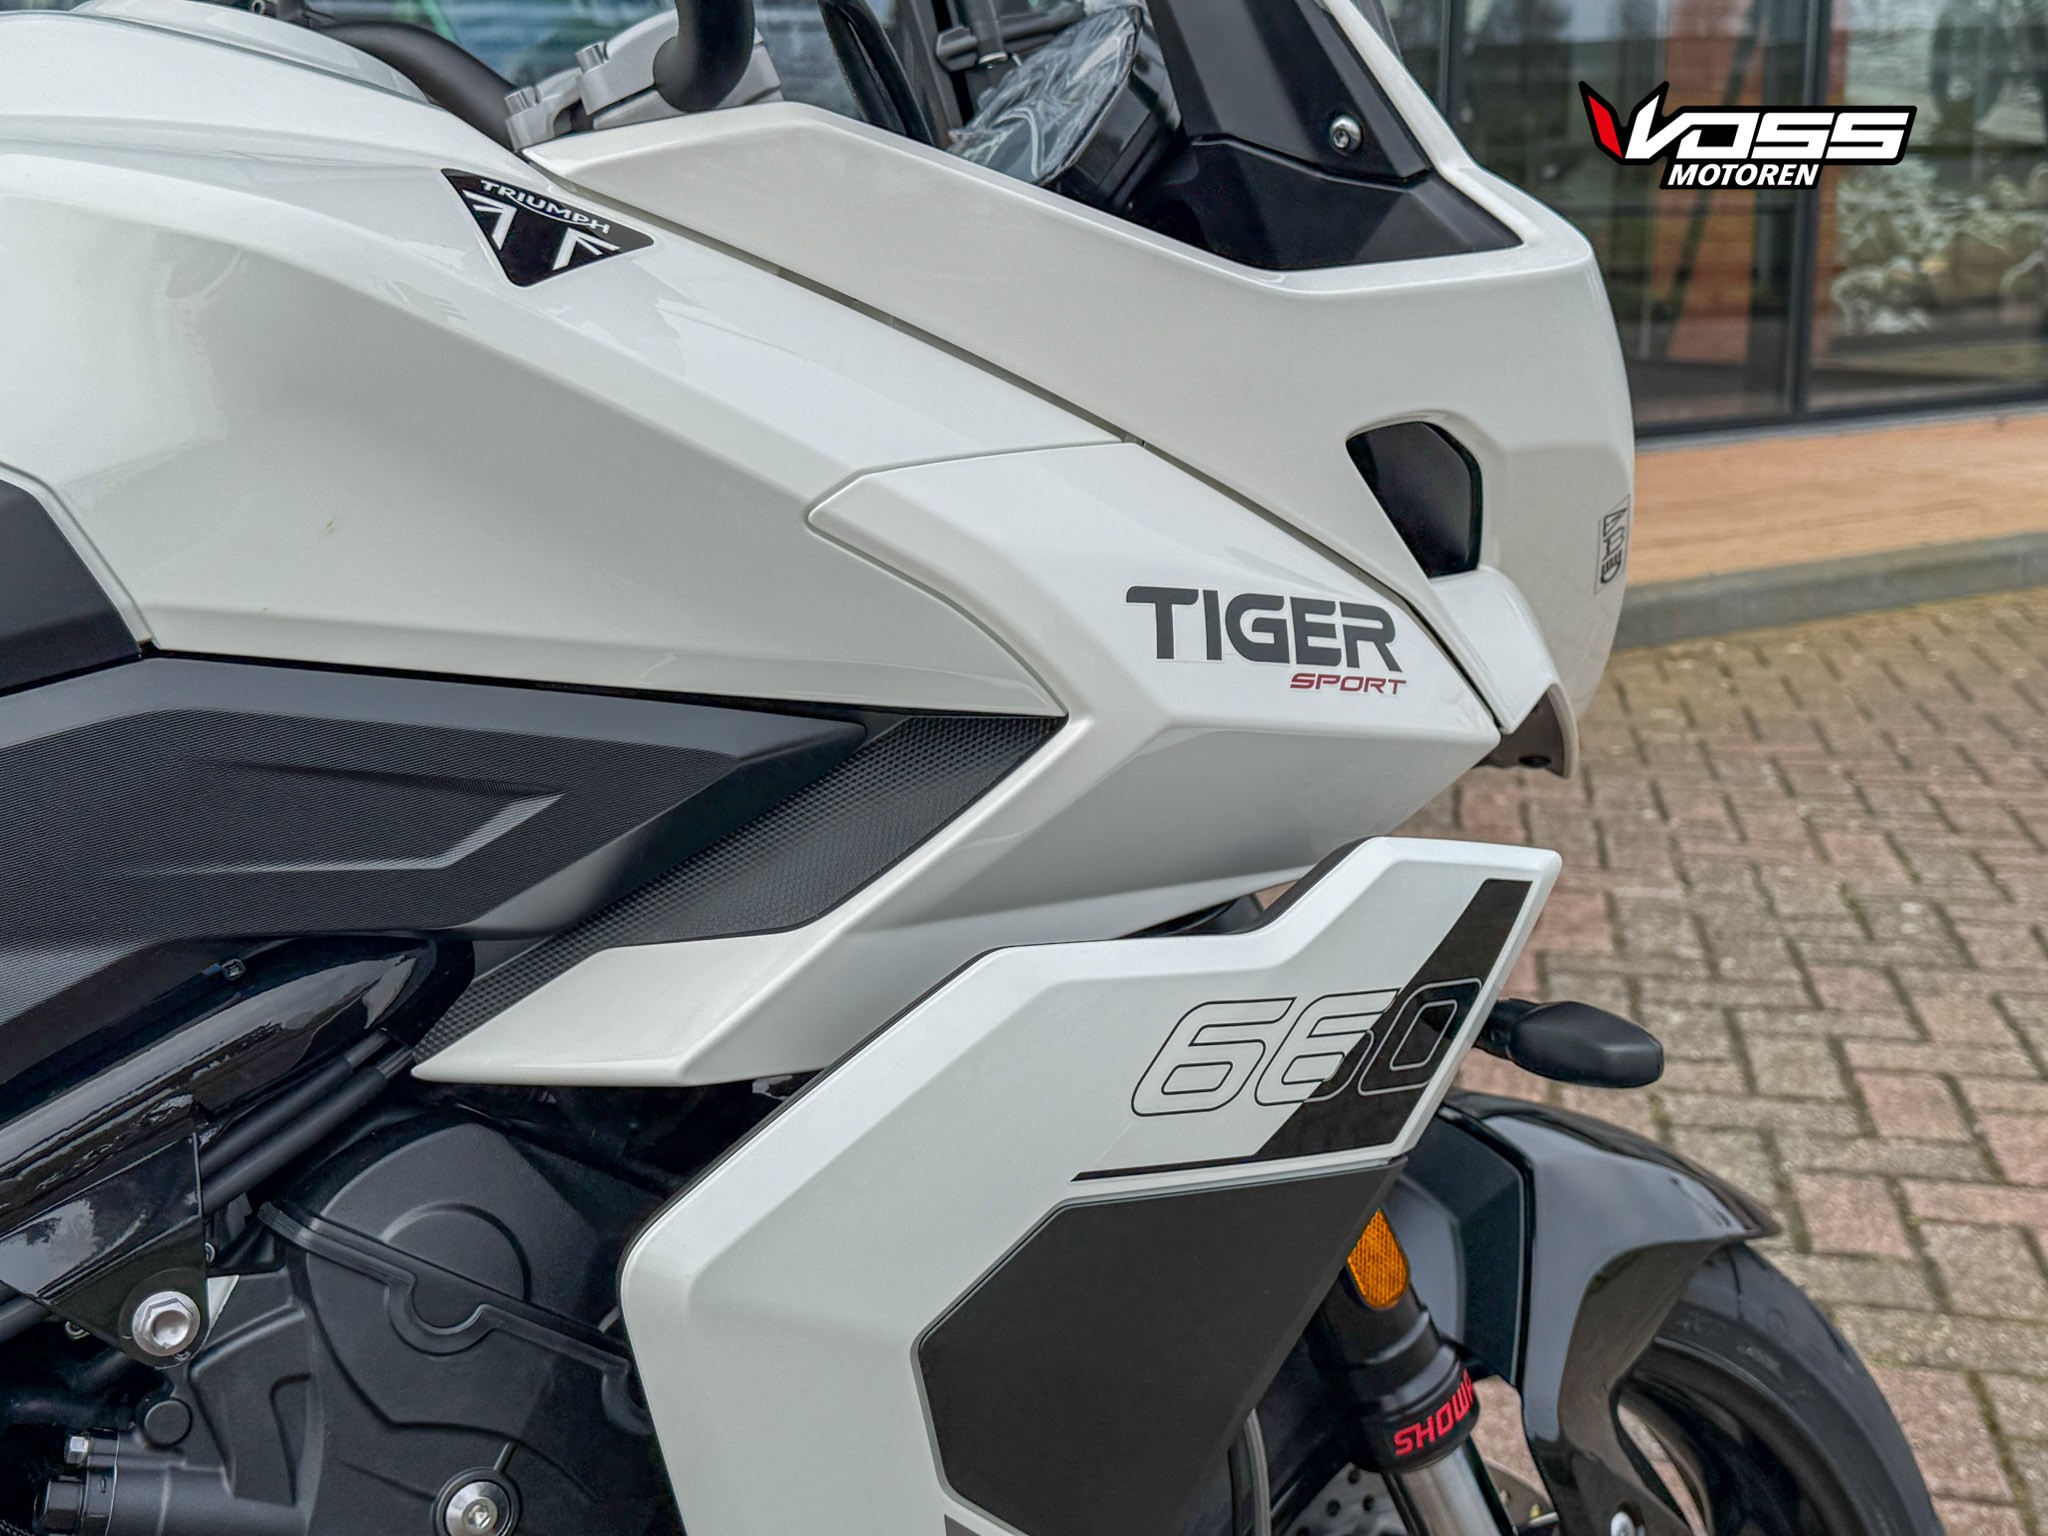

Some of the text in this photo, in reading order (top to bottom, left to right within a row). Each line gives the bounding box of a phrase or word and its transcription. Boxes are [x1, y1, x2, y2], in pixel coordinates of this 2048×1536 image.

[480, 179, 611, 234] TRIUMPH
[1126, 585, 1403, 673] TIGER
[1290, 672, 1407, 695] SPORT
[1131, 977, 1482, 1117] 660
